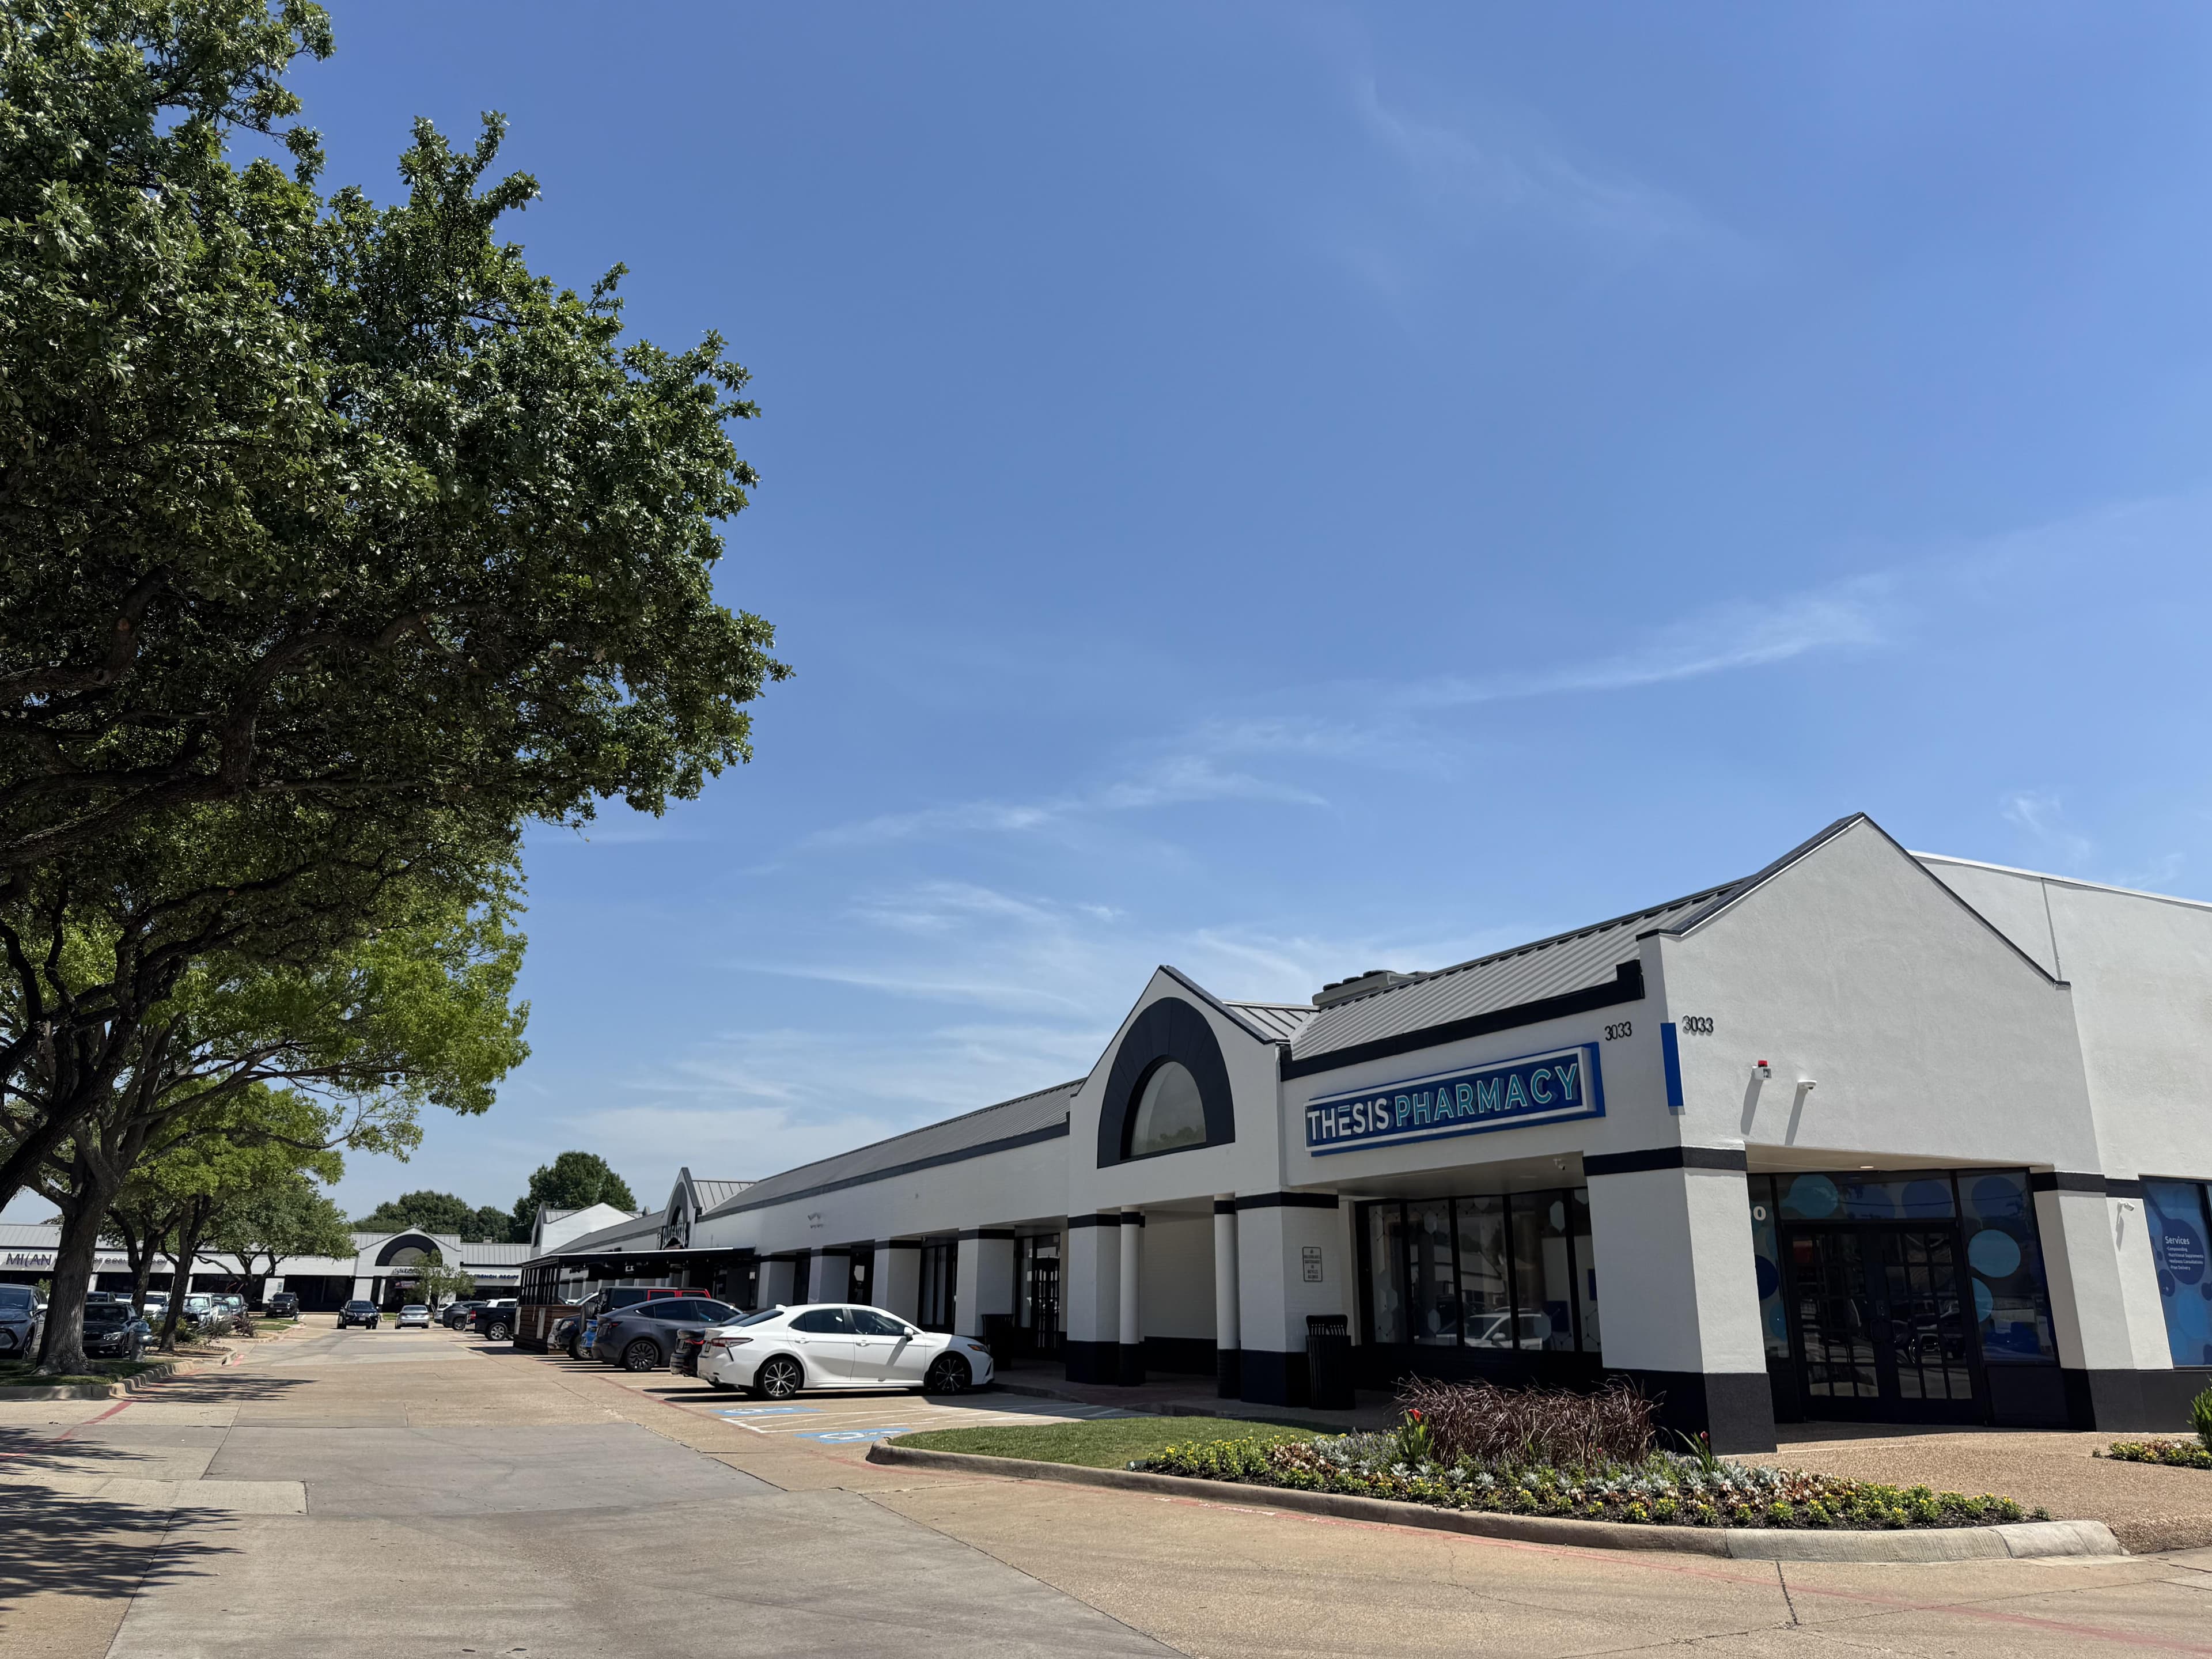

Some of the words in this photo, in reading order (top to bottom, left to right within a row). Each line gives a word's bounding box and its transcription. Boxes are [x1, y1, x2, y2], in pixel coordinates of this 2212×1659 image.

[1604, 1021, 1632, 1041] 3033
[1683, 1015, 1714, 1033] 3033
[1394, 1063, 1578, 1127] PHARMACY
[2165, 1236, 2190, 1245] Services
